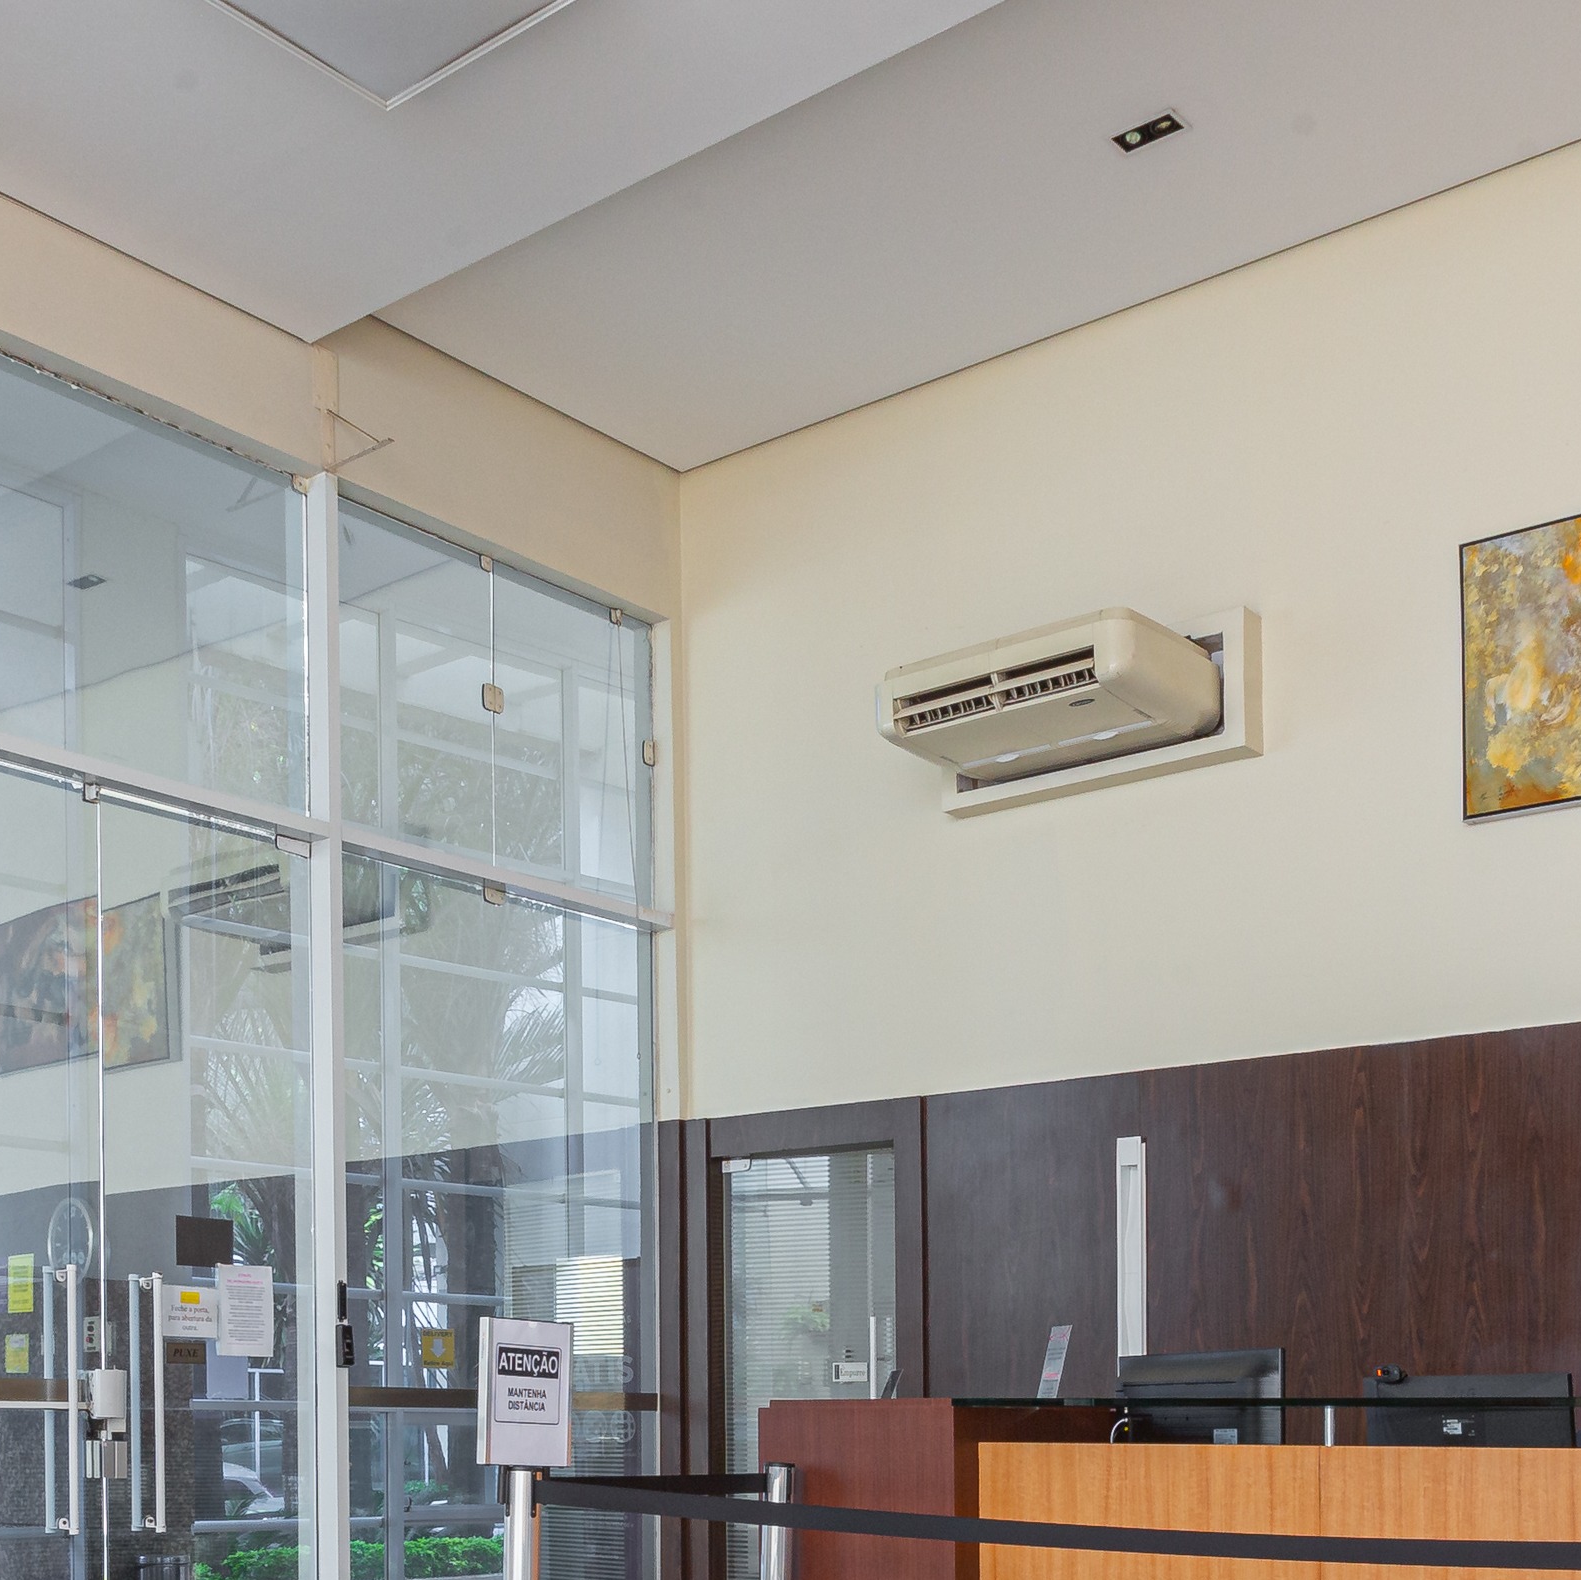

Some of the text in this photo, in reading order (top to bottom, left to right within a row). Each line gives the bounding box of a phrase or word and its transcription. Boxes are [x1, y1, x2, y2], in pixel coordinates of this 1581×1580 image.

[182, 1314, 204, 1322] abertura
[173, 1348, 199, 1358] PUXE
[499, 1352, 558, 1376] ATENÇÃO
[508, 1388, 547, 1399] MANTENHA
[508, 1399, 545, 1411] DISTÂNCIA
